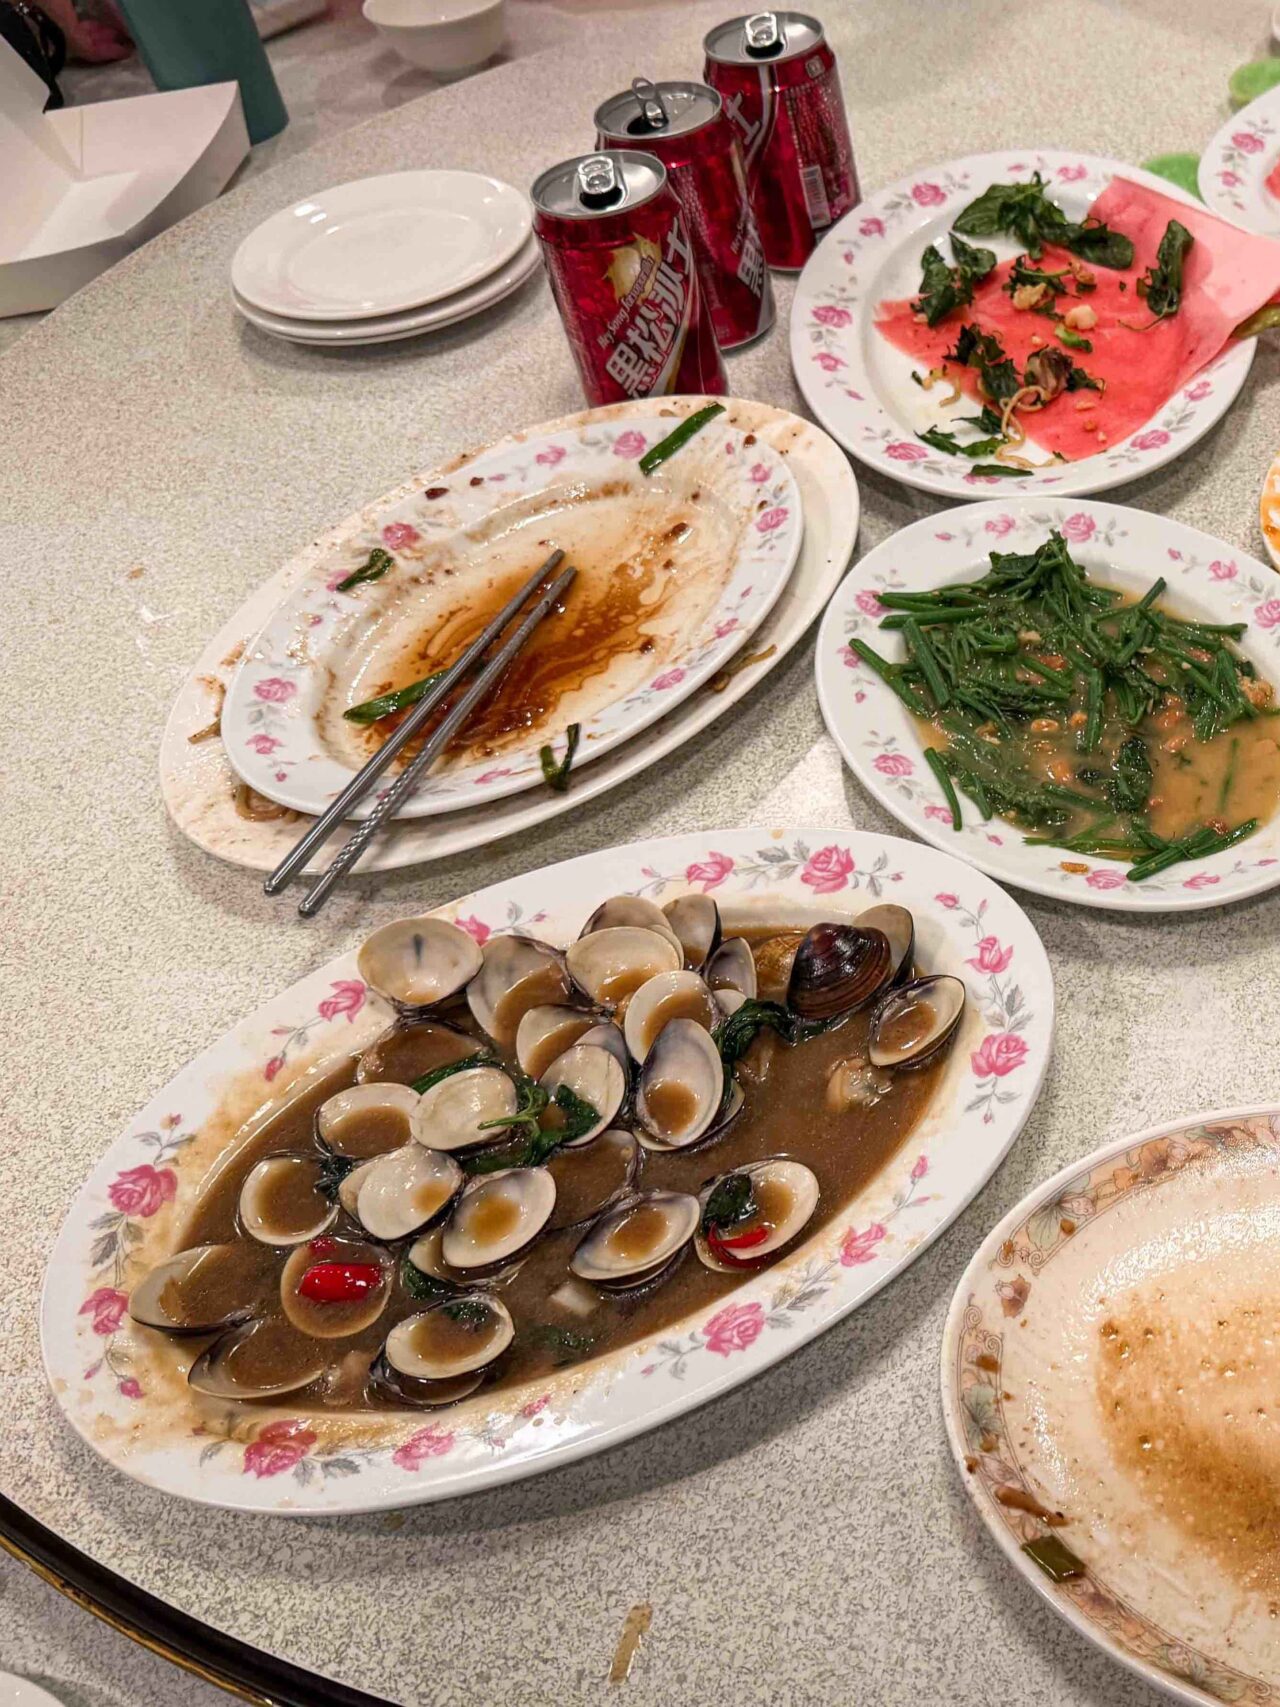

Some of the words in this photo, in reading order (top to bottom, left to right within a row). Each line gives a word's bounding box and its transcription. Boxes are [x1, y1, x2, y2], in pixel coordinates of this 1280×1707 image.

[597, 331, 615, 350] Hey
[607, 307, 629, 335] Song
[605, 216, 690, 399] 黑松沙士
